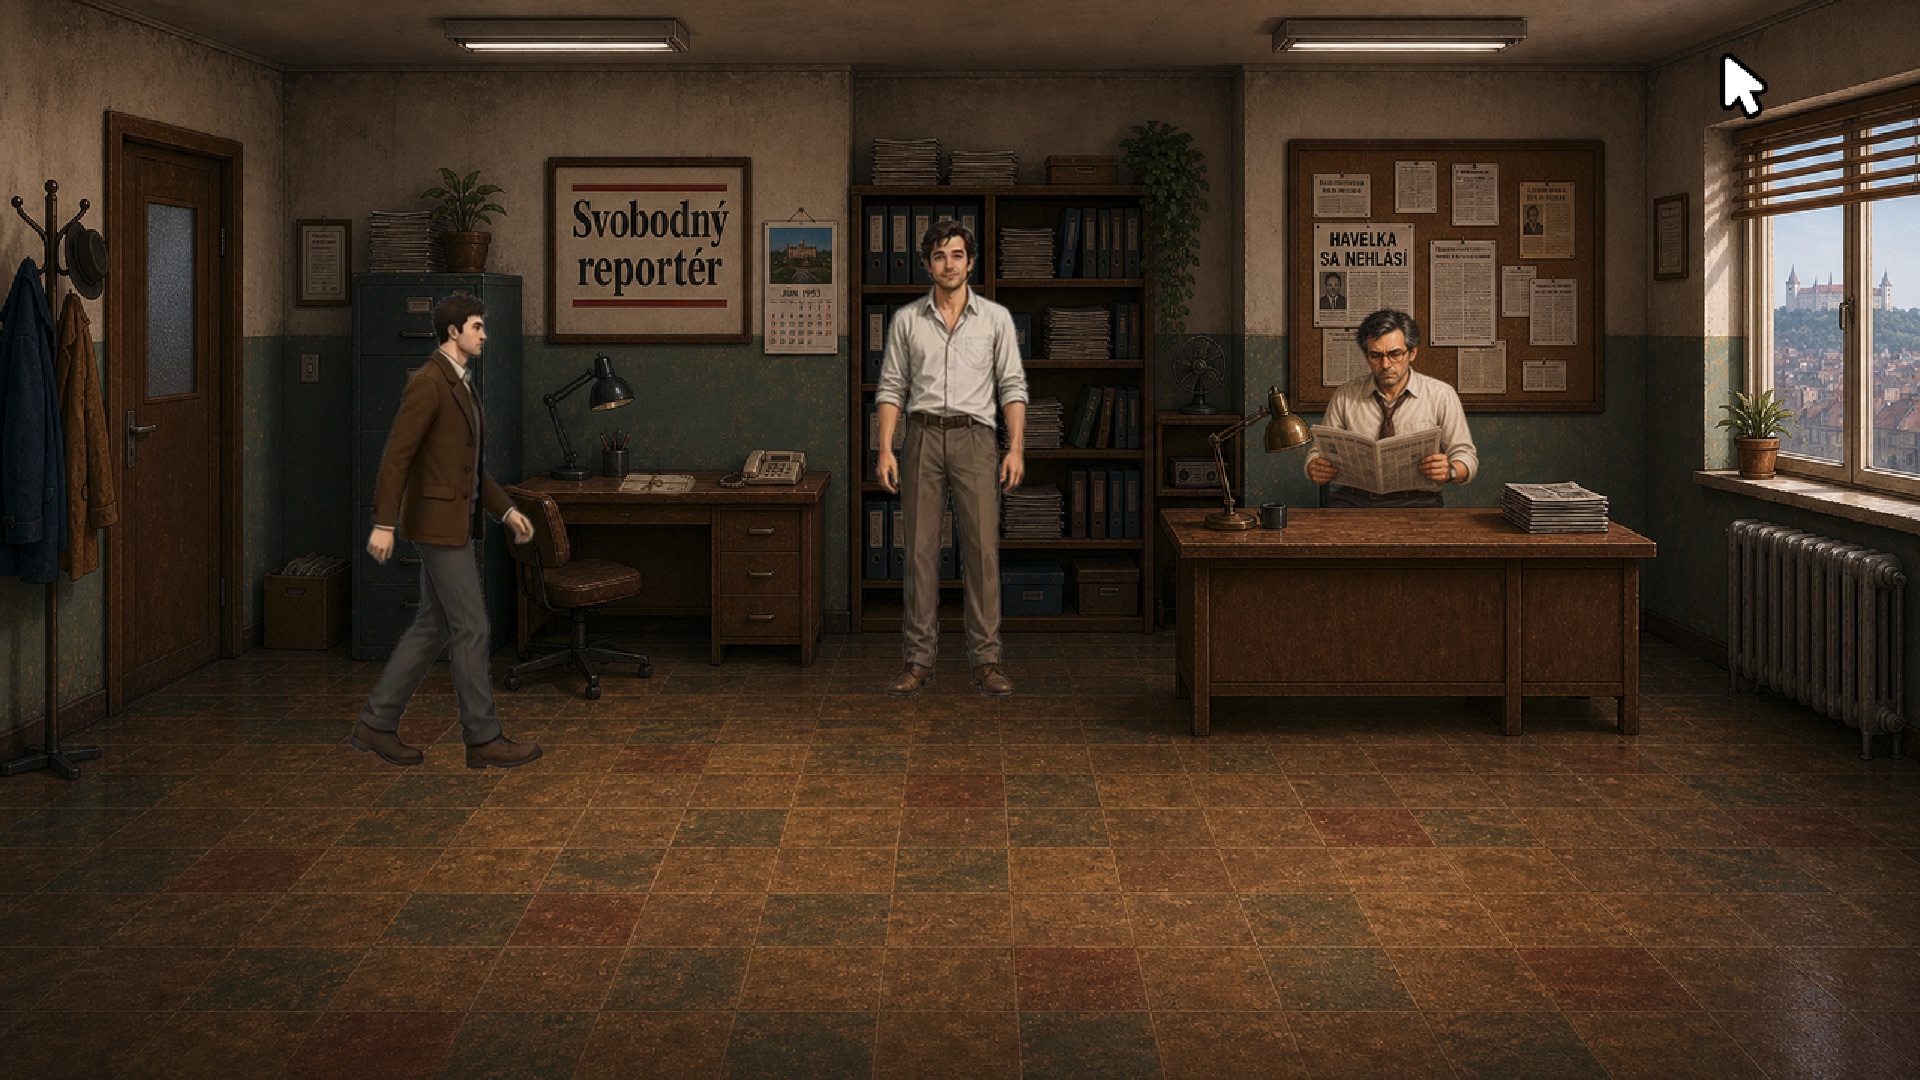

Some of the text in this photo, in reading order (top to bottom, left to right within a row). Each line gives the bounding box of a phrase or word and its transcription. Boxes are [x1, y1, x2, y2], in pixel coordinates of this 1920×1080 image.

[572, 199, 729, 247] Svobodný
[1329, 231, 1397, 247] HAVELKA
[577, 247, 723, 296] reportér
[1320, 251, 1341, 267] SA
